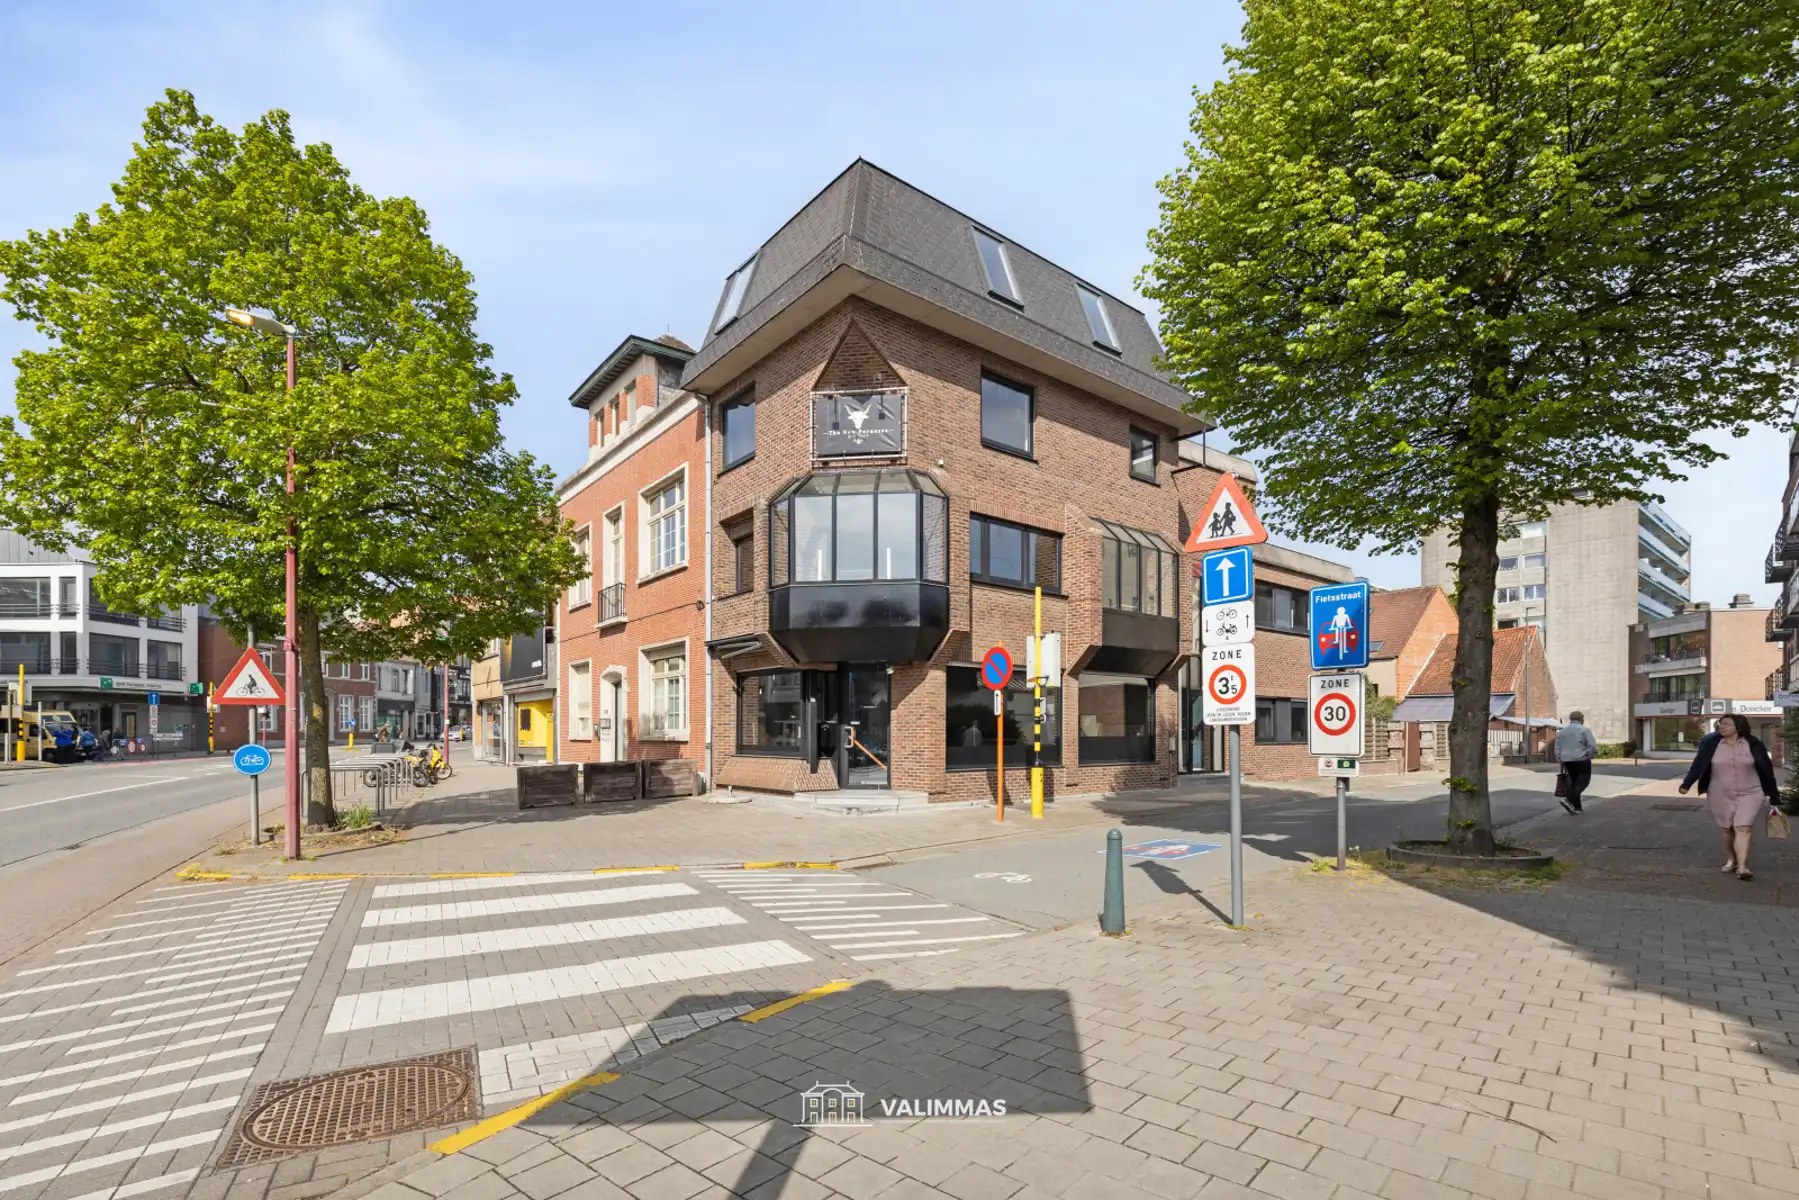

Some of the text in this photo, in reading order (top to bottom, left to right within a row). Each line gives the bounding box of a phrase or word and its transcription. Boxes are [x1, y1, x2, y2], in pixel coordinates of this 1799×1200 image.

[1316, 591, 1362, 603] Fietsstraat
[1212, 650, 1242, 660] ZONE
[1320, 679, 1350, 689] ZONE
[1324, 706, 1346, 722] 30
